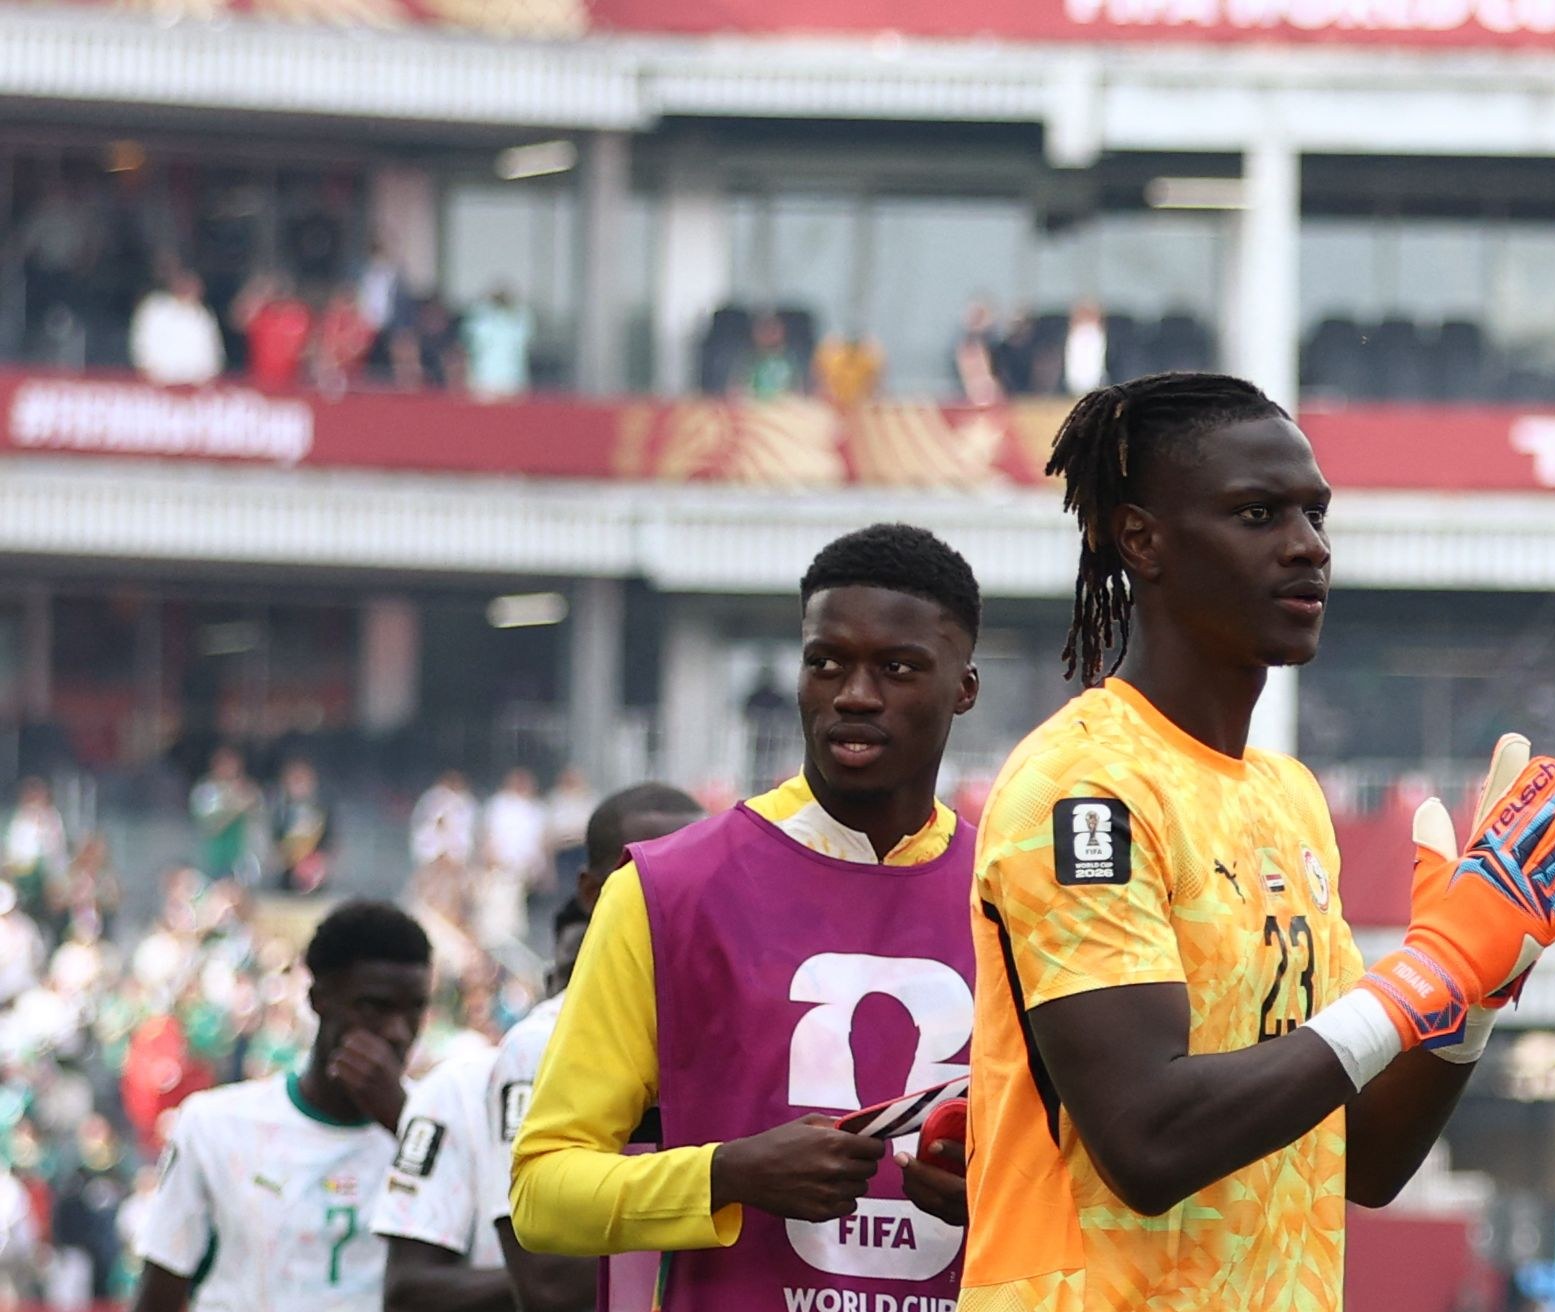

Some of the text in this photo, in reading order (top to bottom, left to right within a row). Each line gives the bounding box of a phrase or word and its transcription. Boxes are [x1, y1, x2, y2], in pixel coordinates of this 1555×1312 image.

[1075, 868, 1114, 878] 2026
[1258, 915, 1314, 1043] 23
[325, 1206, 358, 1285] 7
[839, 1214, 917, 1250] FIFA
